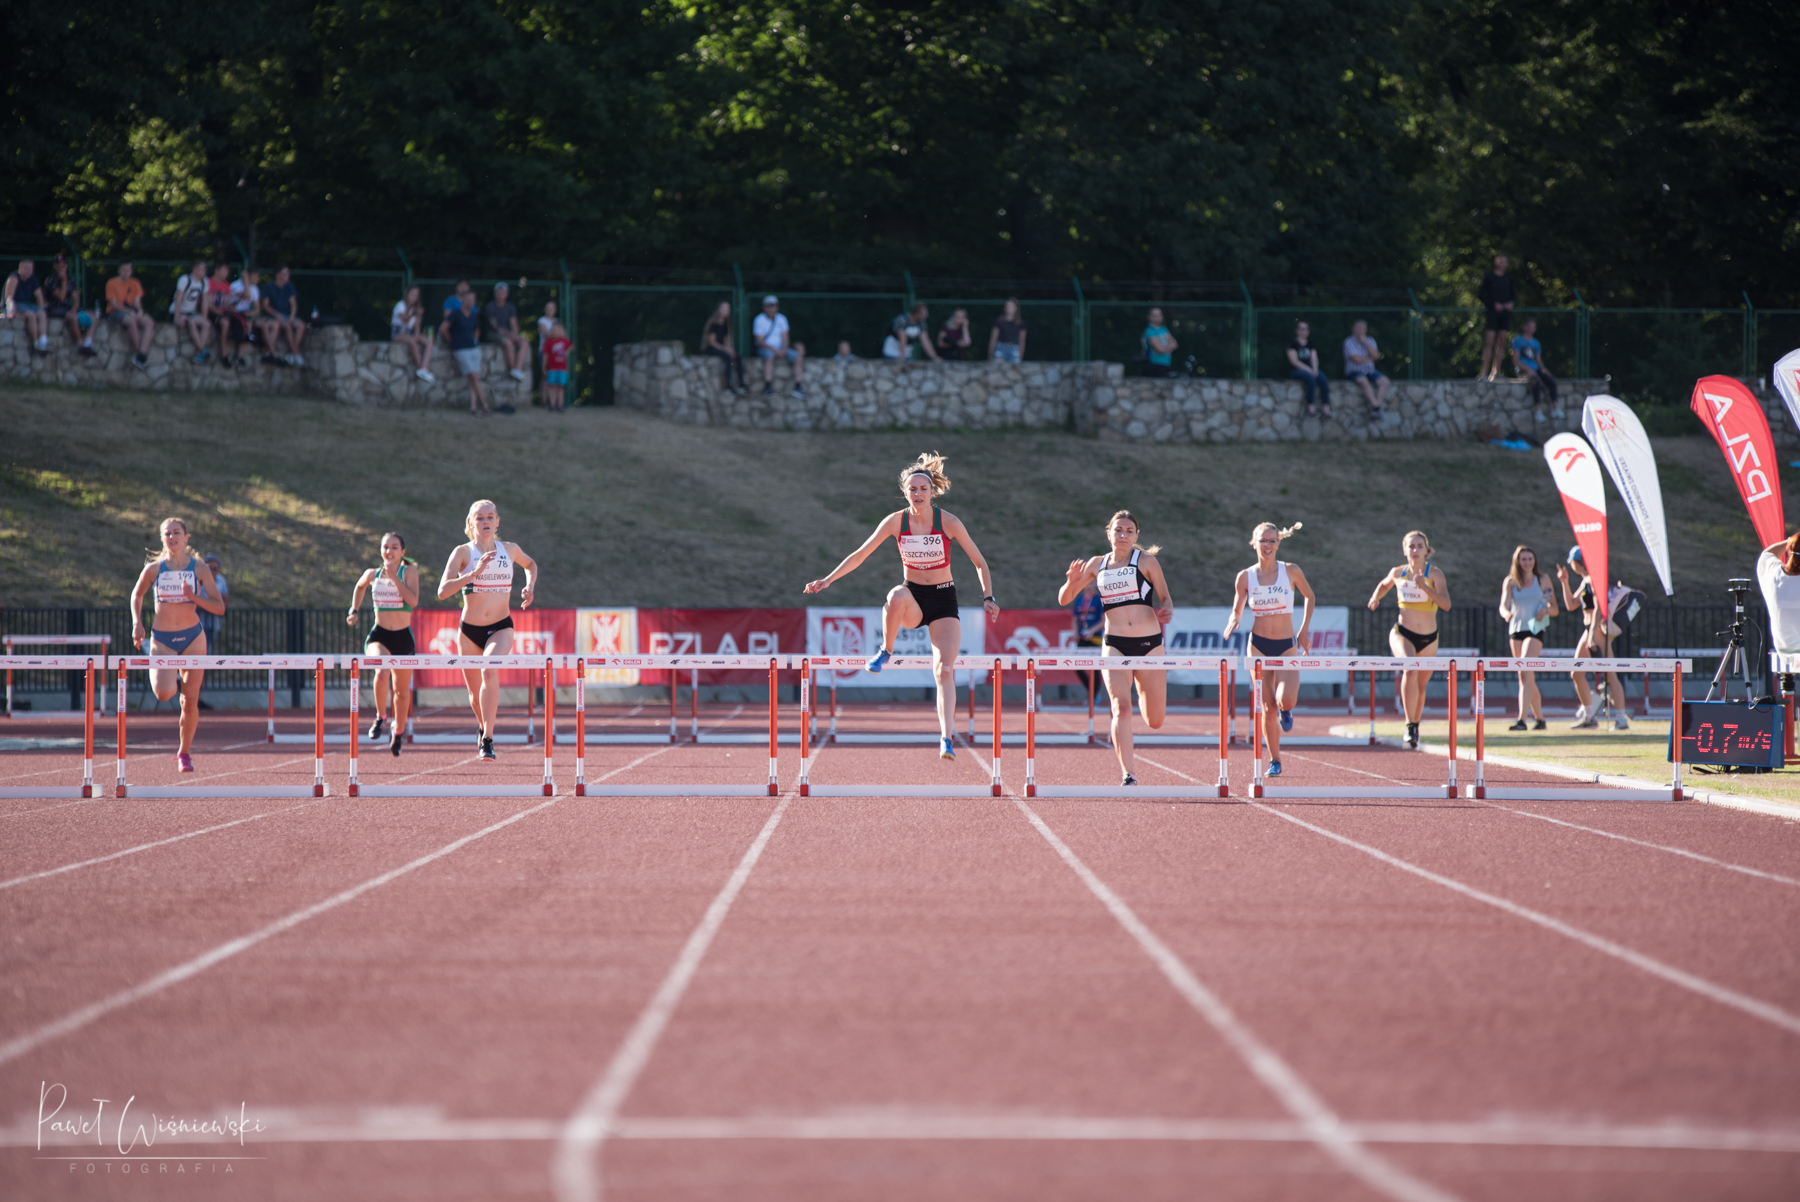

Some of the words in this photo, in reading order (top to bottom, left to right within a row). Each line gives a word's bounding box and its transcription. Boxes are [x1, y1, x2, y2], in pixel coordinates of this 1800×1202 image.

[922, 536, 941, 545] 396
[901, 550, 944, 558] LESZCZYŃSKA
[497, 560, 509, 568] 78
[178, 572, 193, 580] 199
[1117, 568, 1135, 577] 603
[475, 573, 511, 581] WASIELEWSKA
[936, 582, 950, 590] NIKE
[1103, 581, 1129, 591] KĘDZIA
[1267, 586, 1284, 594] 196
[1681, 722, 1739, 754] -0.7
